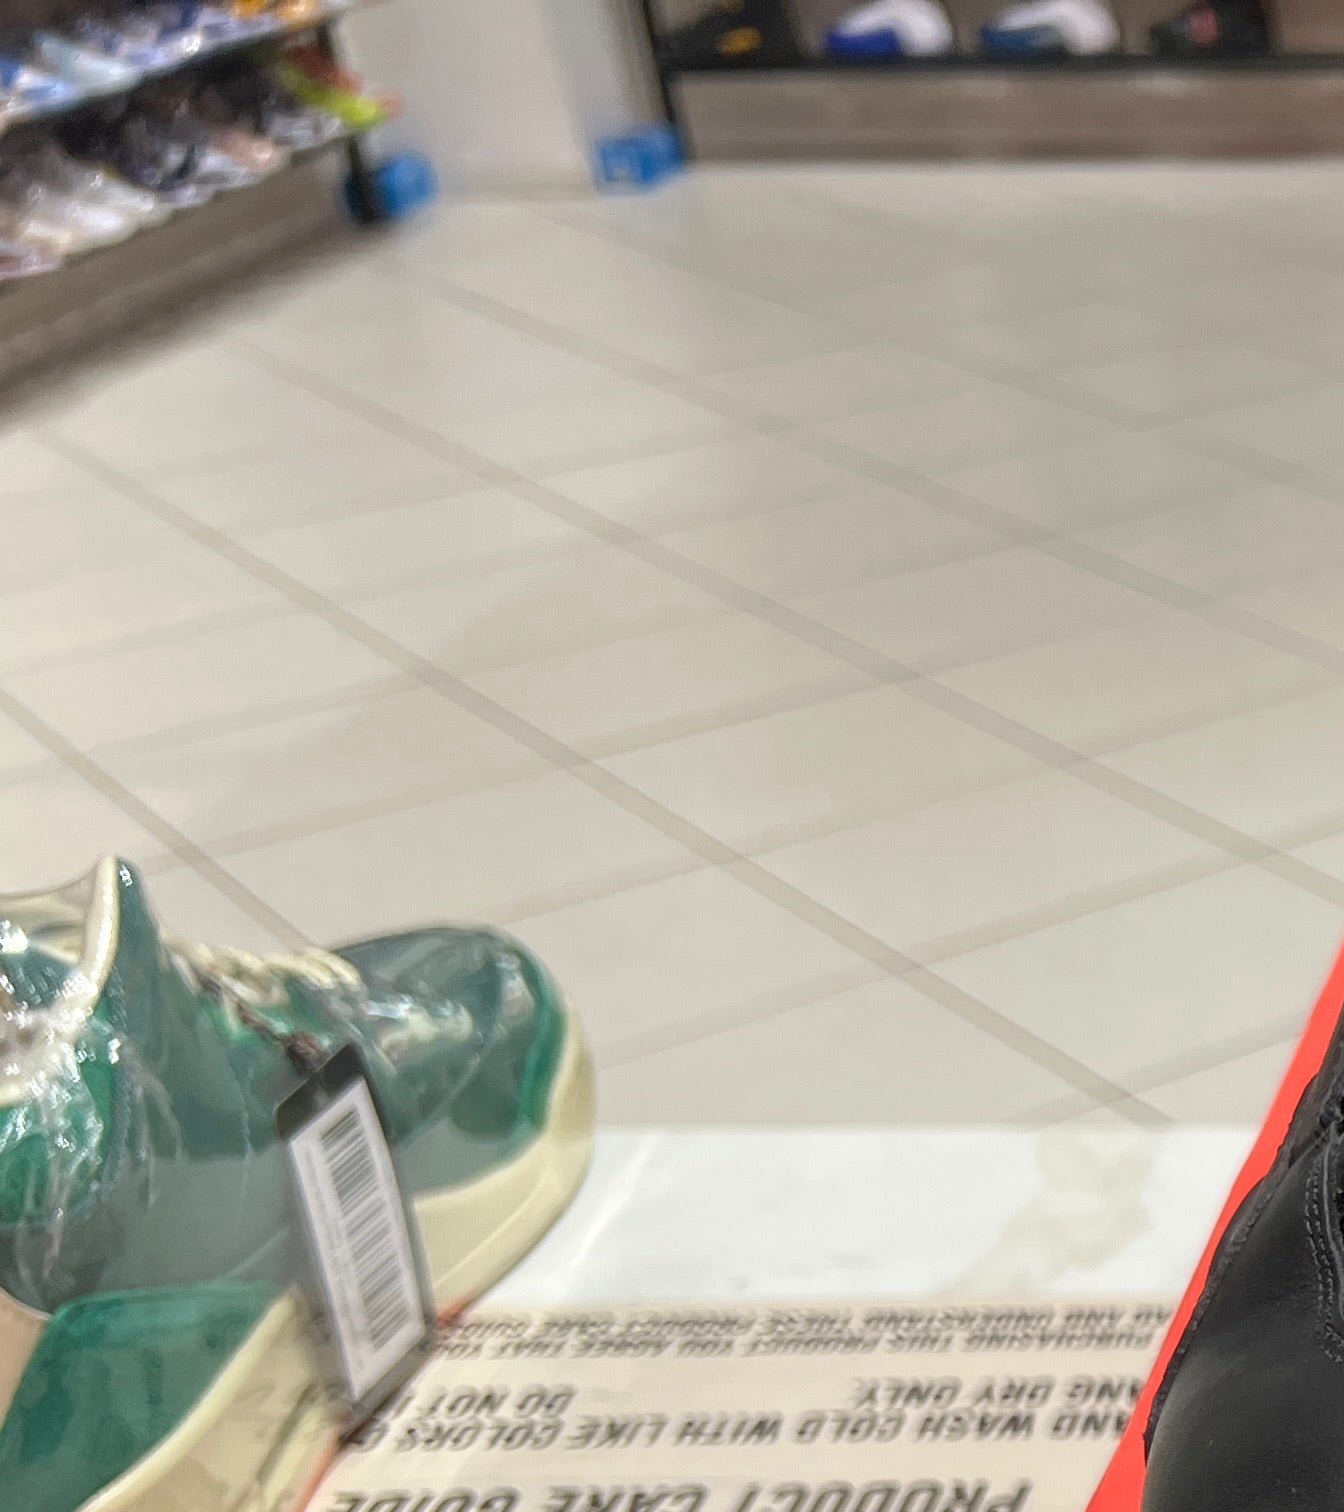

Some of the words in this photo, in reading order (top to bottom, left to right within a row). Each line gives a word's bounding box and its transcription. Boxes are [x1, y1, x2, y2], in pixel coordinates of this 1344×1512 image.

[418, 1386, 509, 1419] NOT
[512, 1384, 576, 1418] DO
[969, 1375, 1056, 1410] DRY
[1064, 1376, 1142, 1409] ANG
[394, 1419, 567, 1452] COLORS
[566, 1414, 668, 1450] LIKE
[672, 1412, 783, 1447] WITH
[791, 1410, 908, 1444] COLD
[915, 1410, 1036, 1442] WASH
[1049, 1410, 1128, 1441] AND
